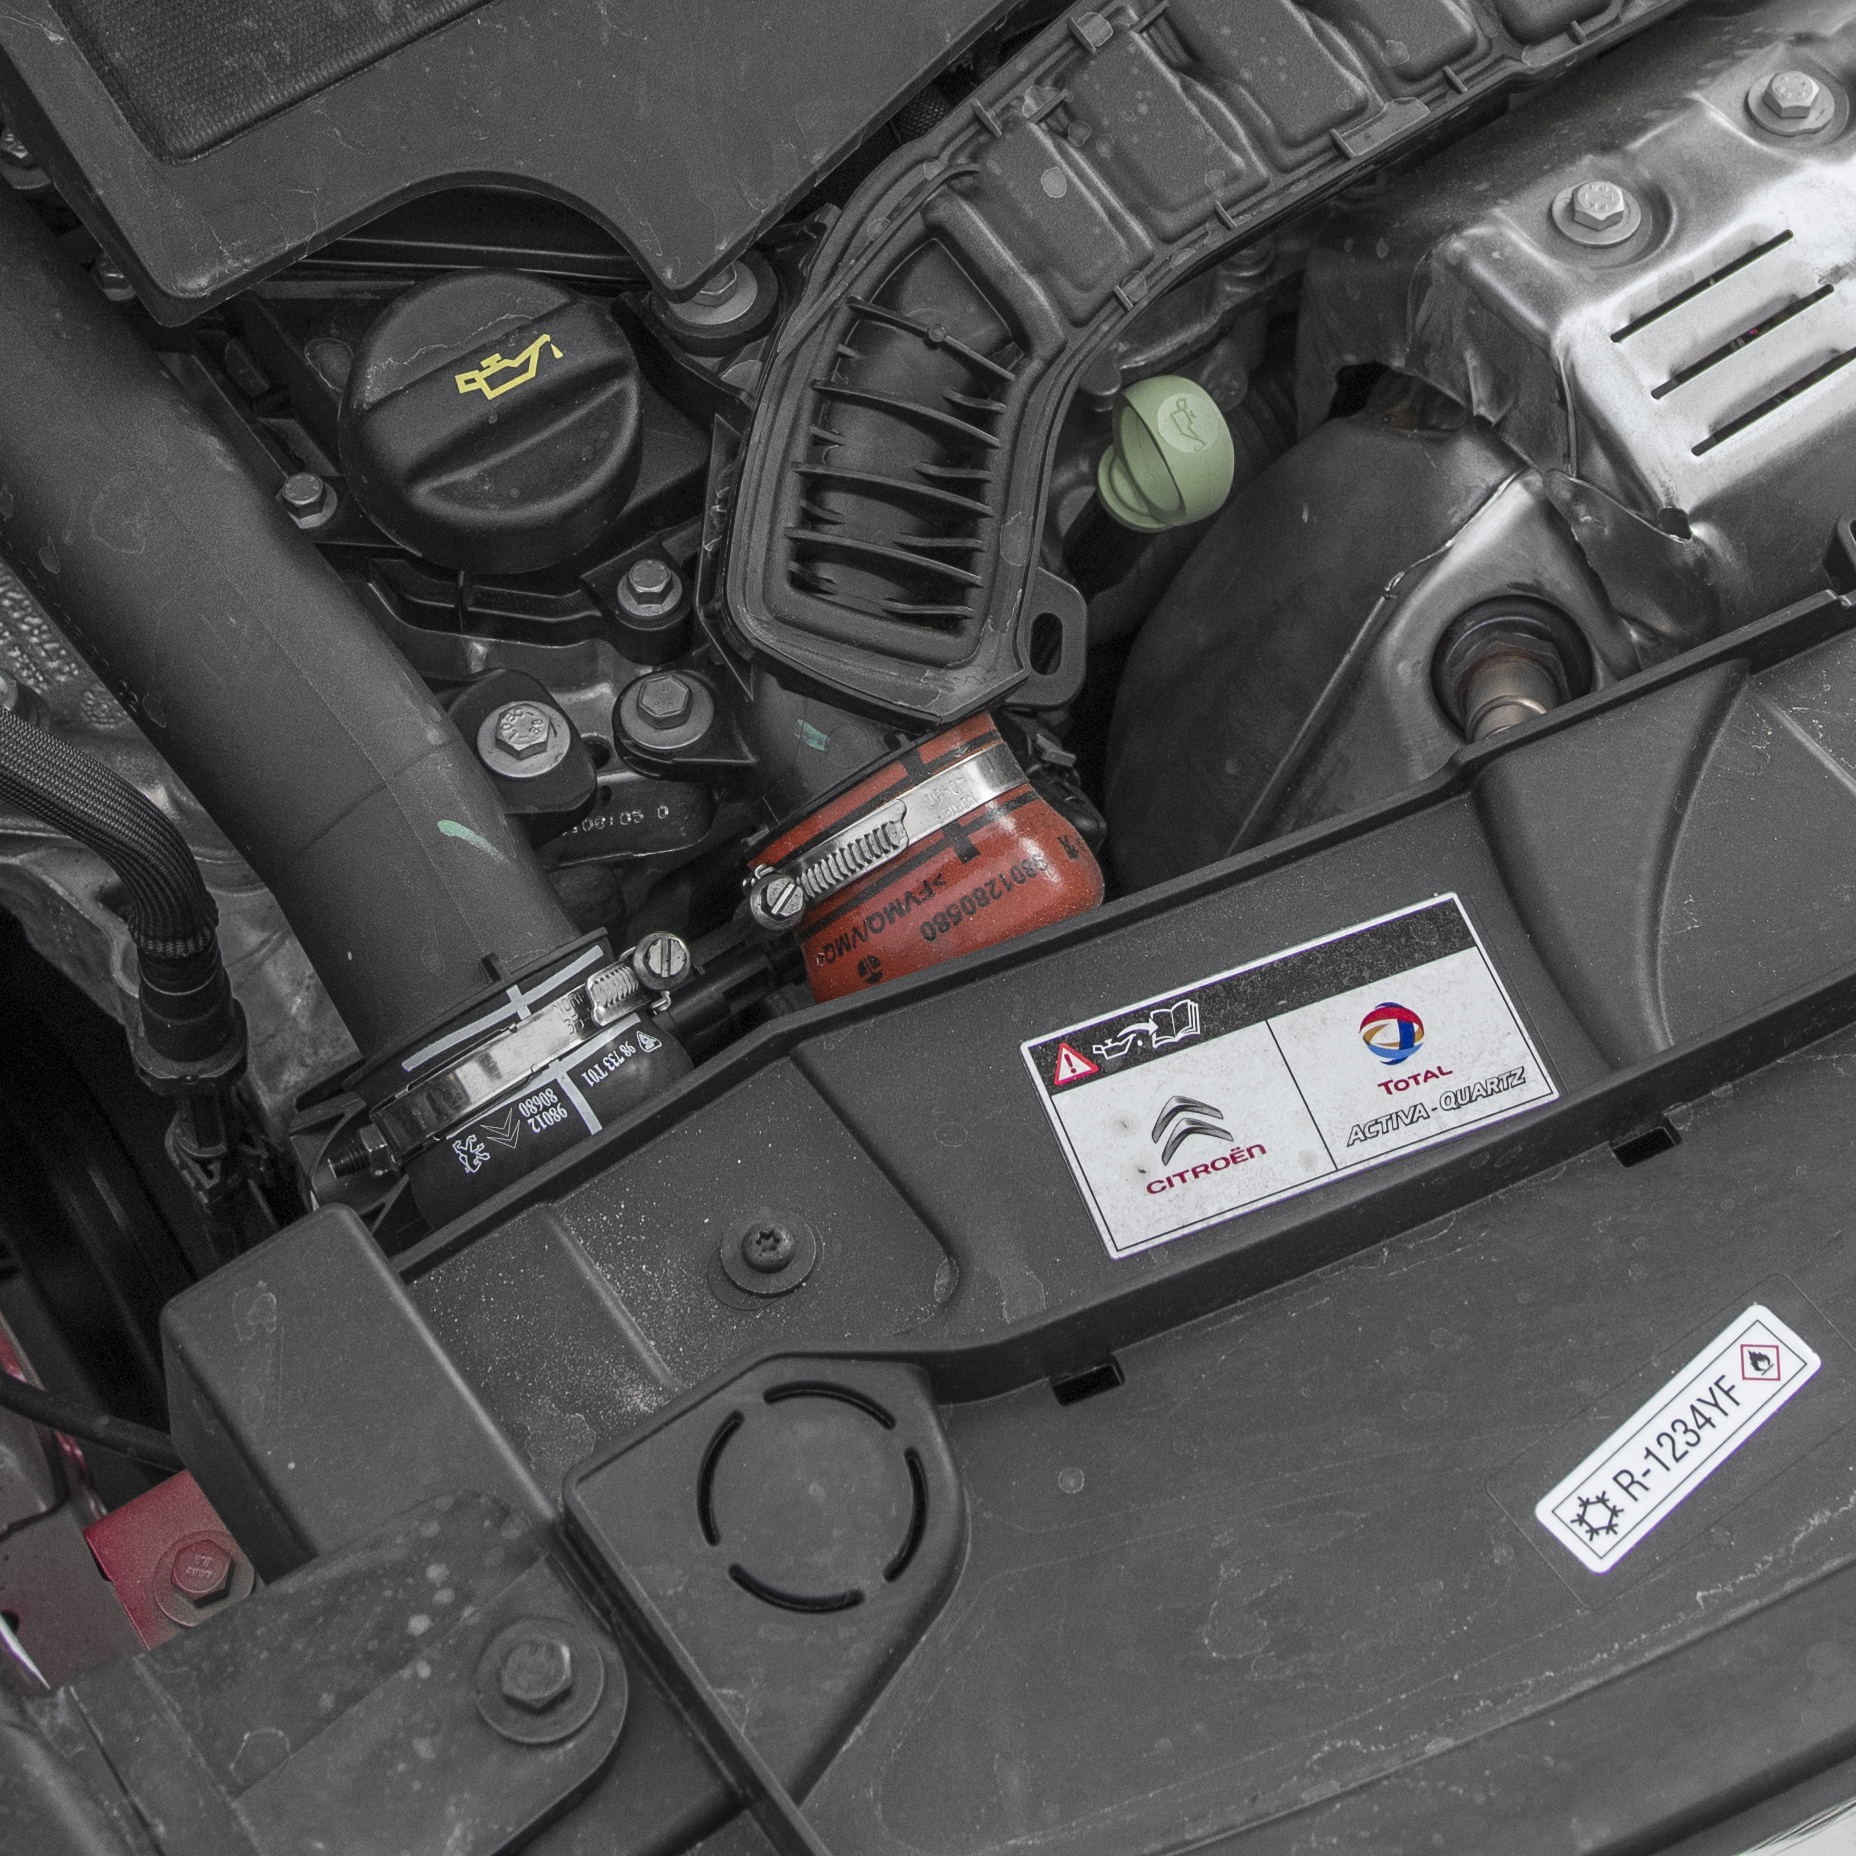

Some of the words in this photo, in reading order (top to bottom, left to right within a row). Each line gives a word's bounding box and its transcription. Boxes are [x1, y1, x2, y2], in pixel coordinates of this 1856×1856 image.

[602, 1050, 622, 1072] 733
[619, 1040, 637, 1058] 98
[1377, 1064, 1453, 1096] TOTAL
[518, 1088, 558, 1118] 80680
[527, 1102, 568, 1134] 98012
[1346, 1102, 1431, 1149] ACTIVA
[1437, 1065, 1527, 1118] QUARTZ
[1612, 1373, 1742, 1503] R-1234YF
